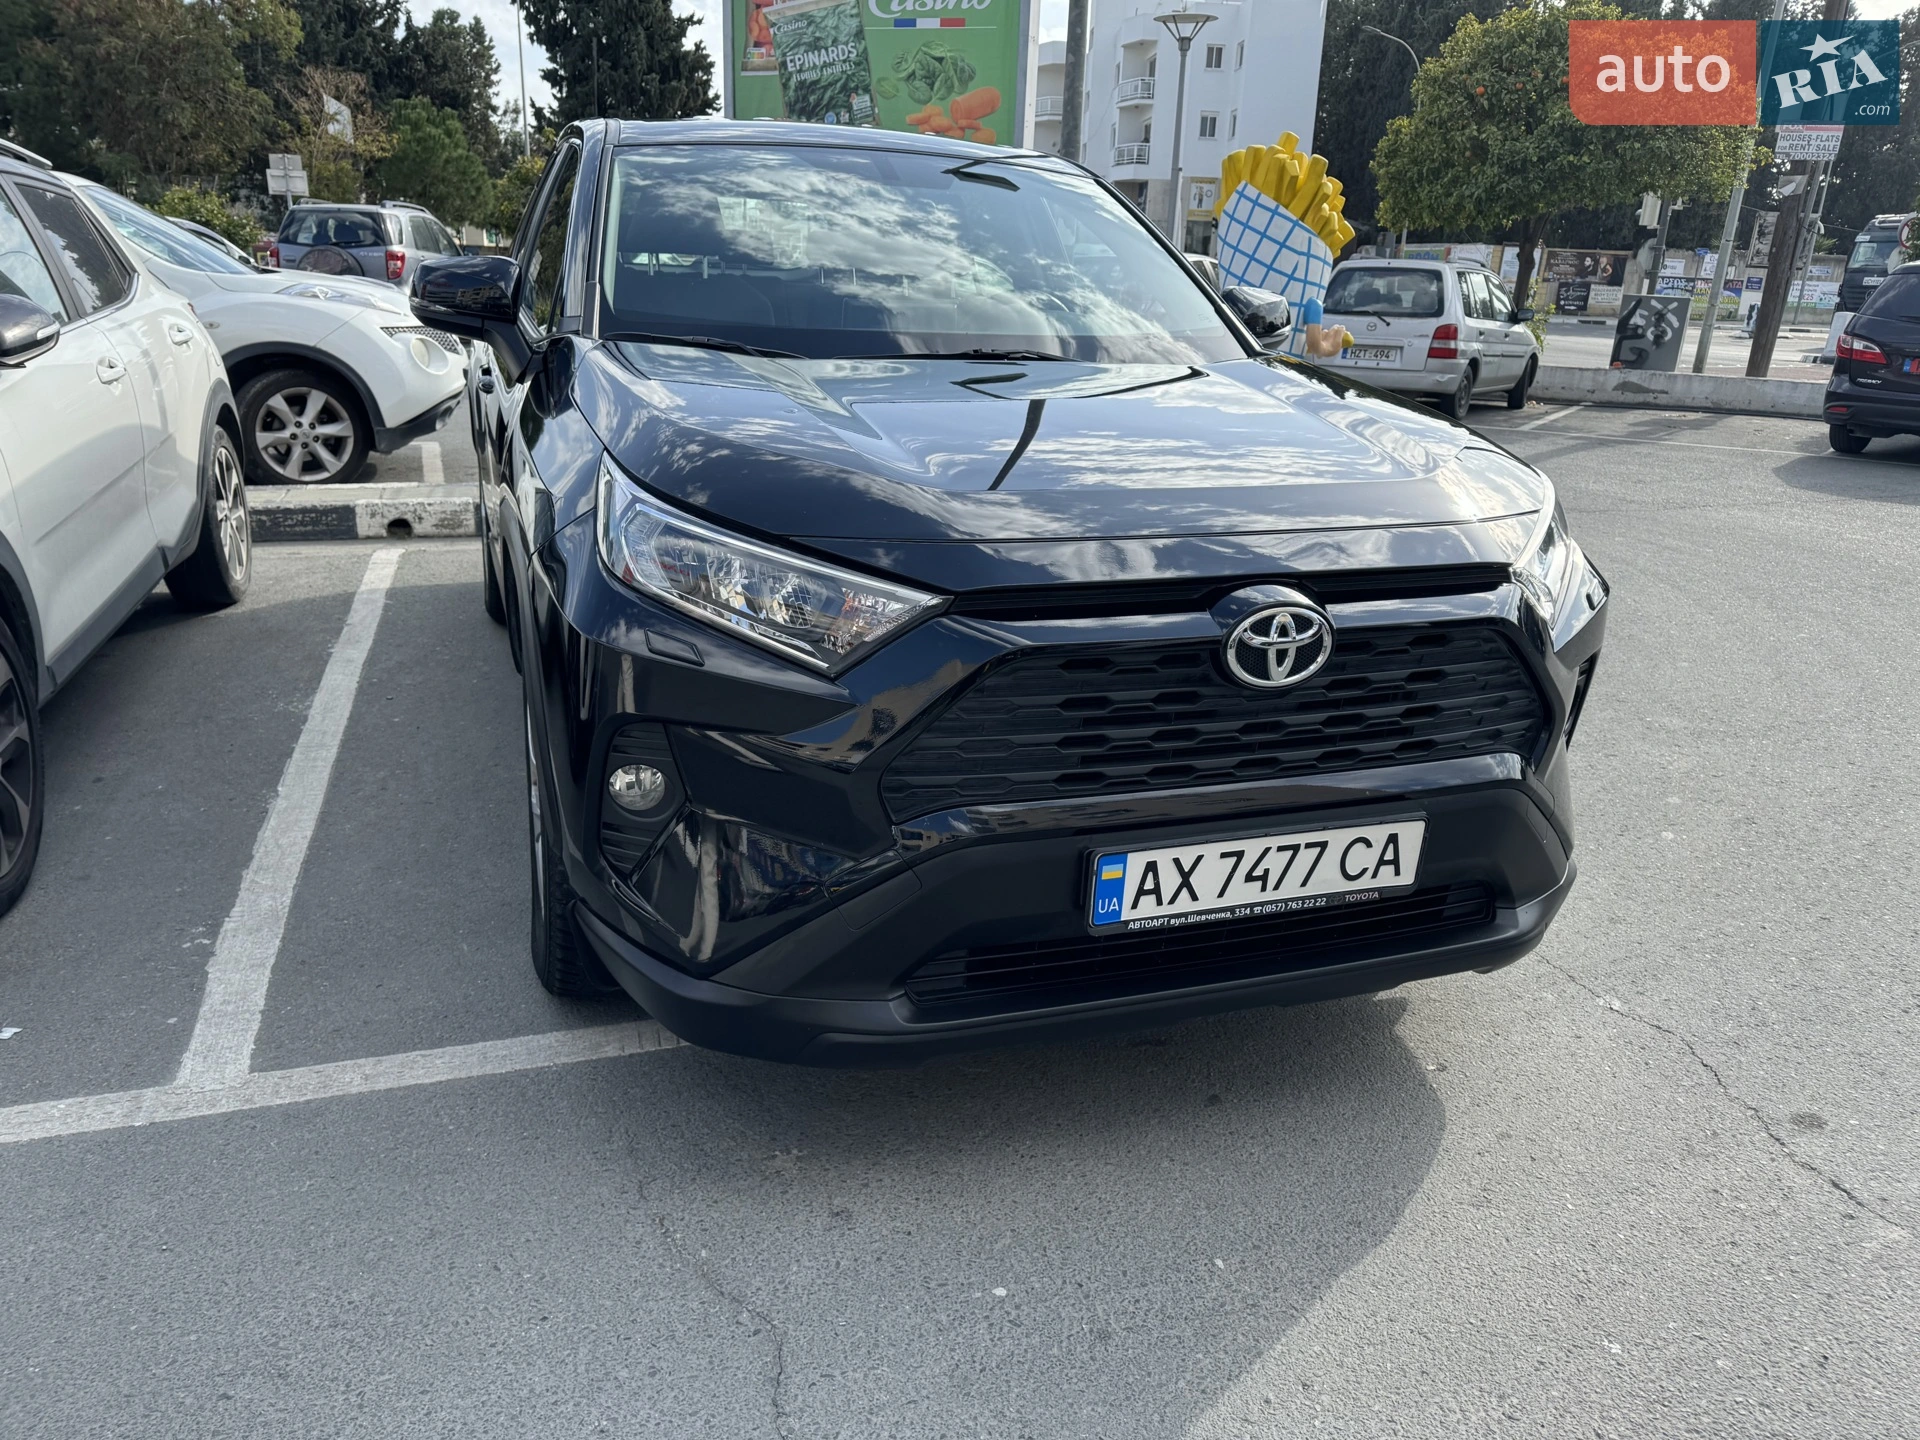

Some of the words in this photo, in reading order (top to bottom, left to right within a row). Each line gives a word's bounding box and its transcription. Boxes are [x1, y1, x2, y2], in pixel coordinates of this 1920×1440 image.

[774, 19, 808, 35] Casino
[785, 42, 857, 72] ÉPINARDS
[1788, 143, 1839, 153] RENT/SALE
[1789, 152, 1835, 161] 70002324
[1130, 853, 1205, 911] AX
[1216, 840, 1329, 899] 7477
[1339, 832, 1401, 882] CA
[1097, 896, 1119, 914] UA
[1344, 891, 1379, 902] TOYOTA
[1127, 917, 1169, 930] АВТОАРТ
[1234, 907, 1251, 917] 334
[1262, 903, 1285, 914] (057)
[1286, 900, 1303, 910] 763
[1303, 899, 1315, 908] 22
[1315, 897, 1327, 906] 22
